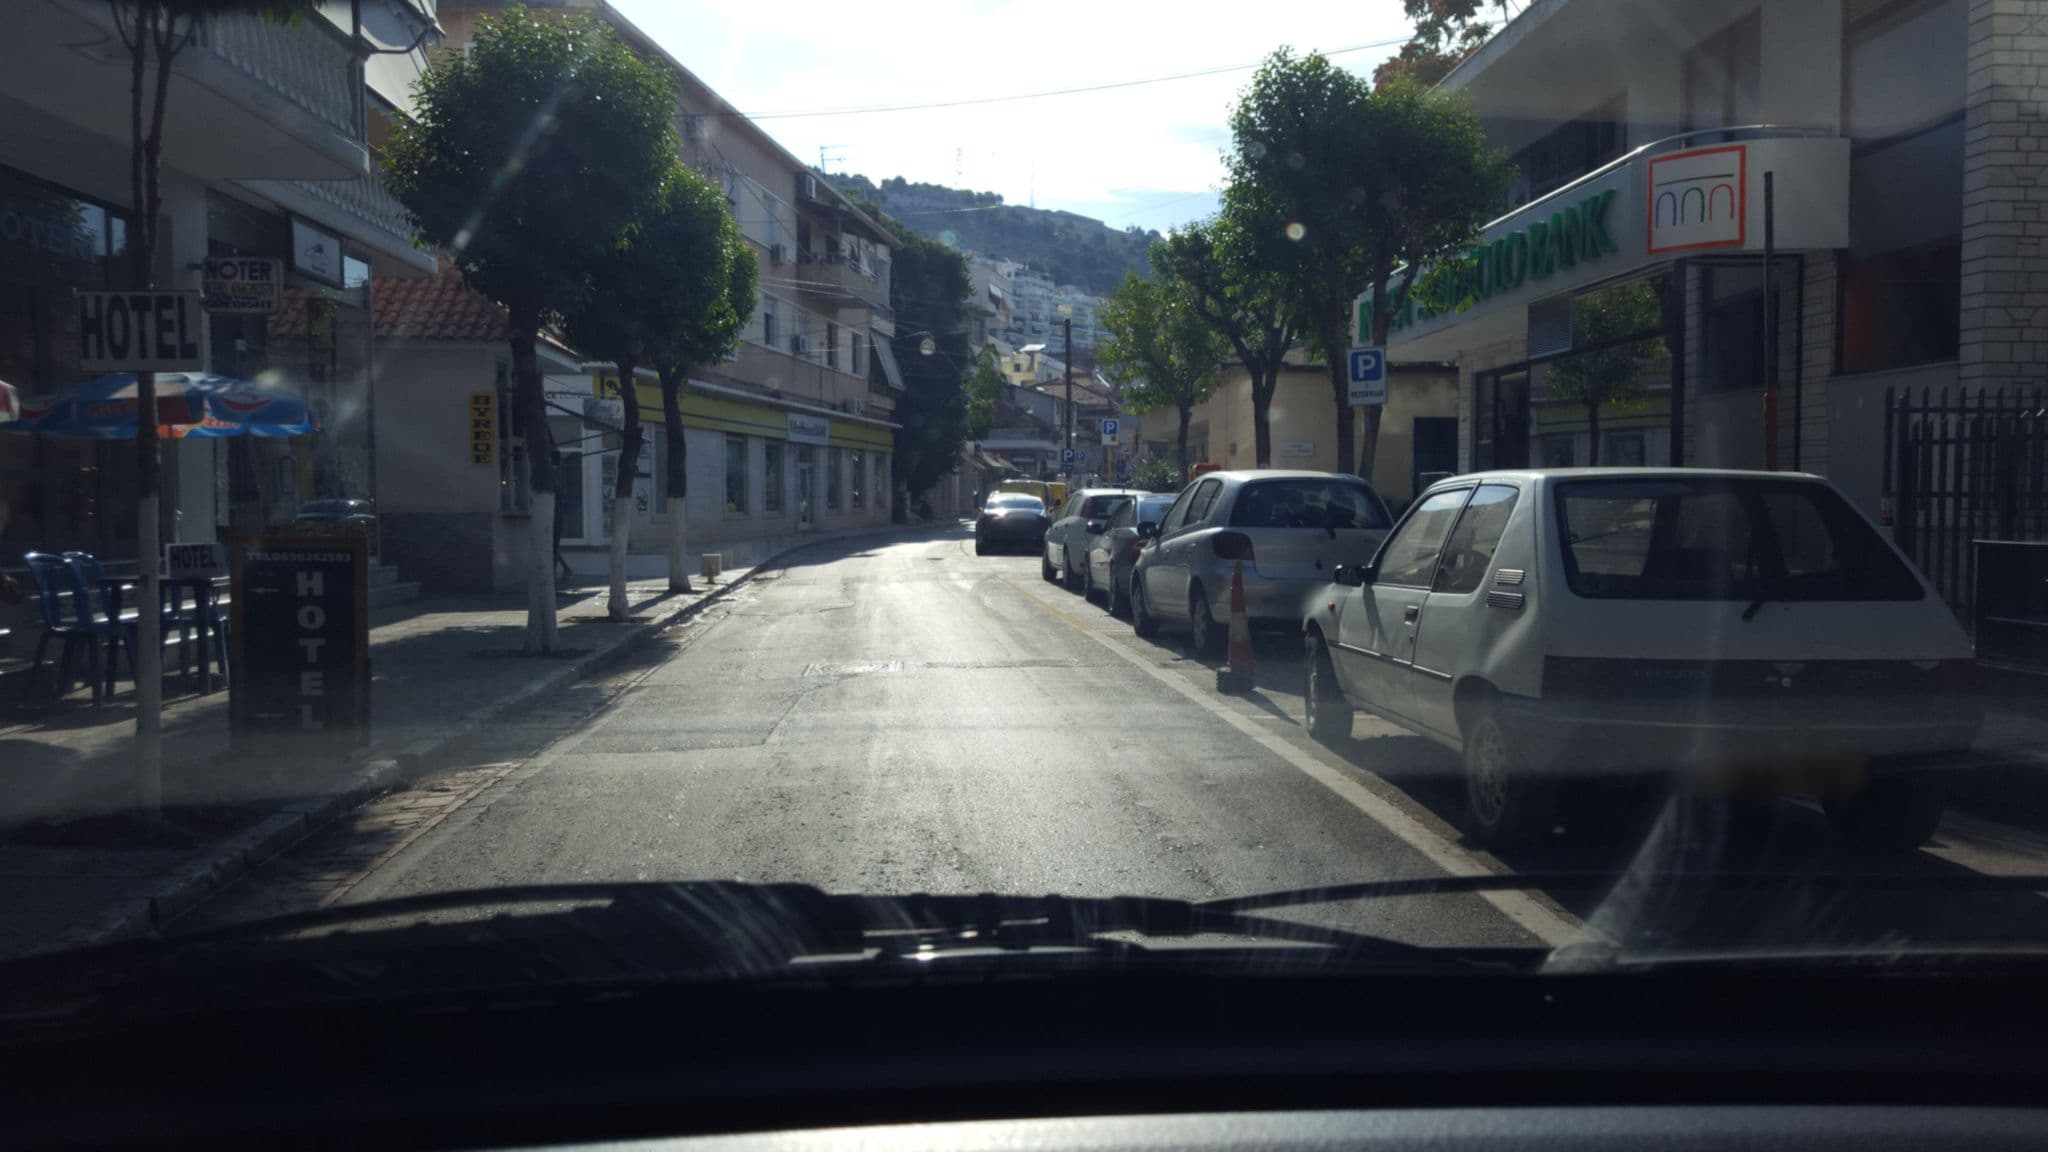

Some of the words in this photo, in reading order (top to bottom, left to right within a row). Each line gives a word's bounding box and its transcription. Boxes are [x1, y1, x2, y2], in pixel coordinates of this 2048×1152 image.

[206, 261, 272, 281] NOTER
[80, 294, 200, 360] HOTEL
[1358, 354, 1377, 379] P
[1106, 422, 1116, 434] P
[1064, 449, 1073, 461] P
[171, 546, 217, 568] HOTEL
[295, 571, 326, 729] HOTEL
